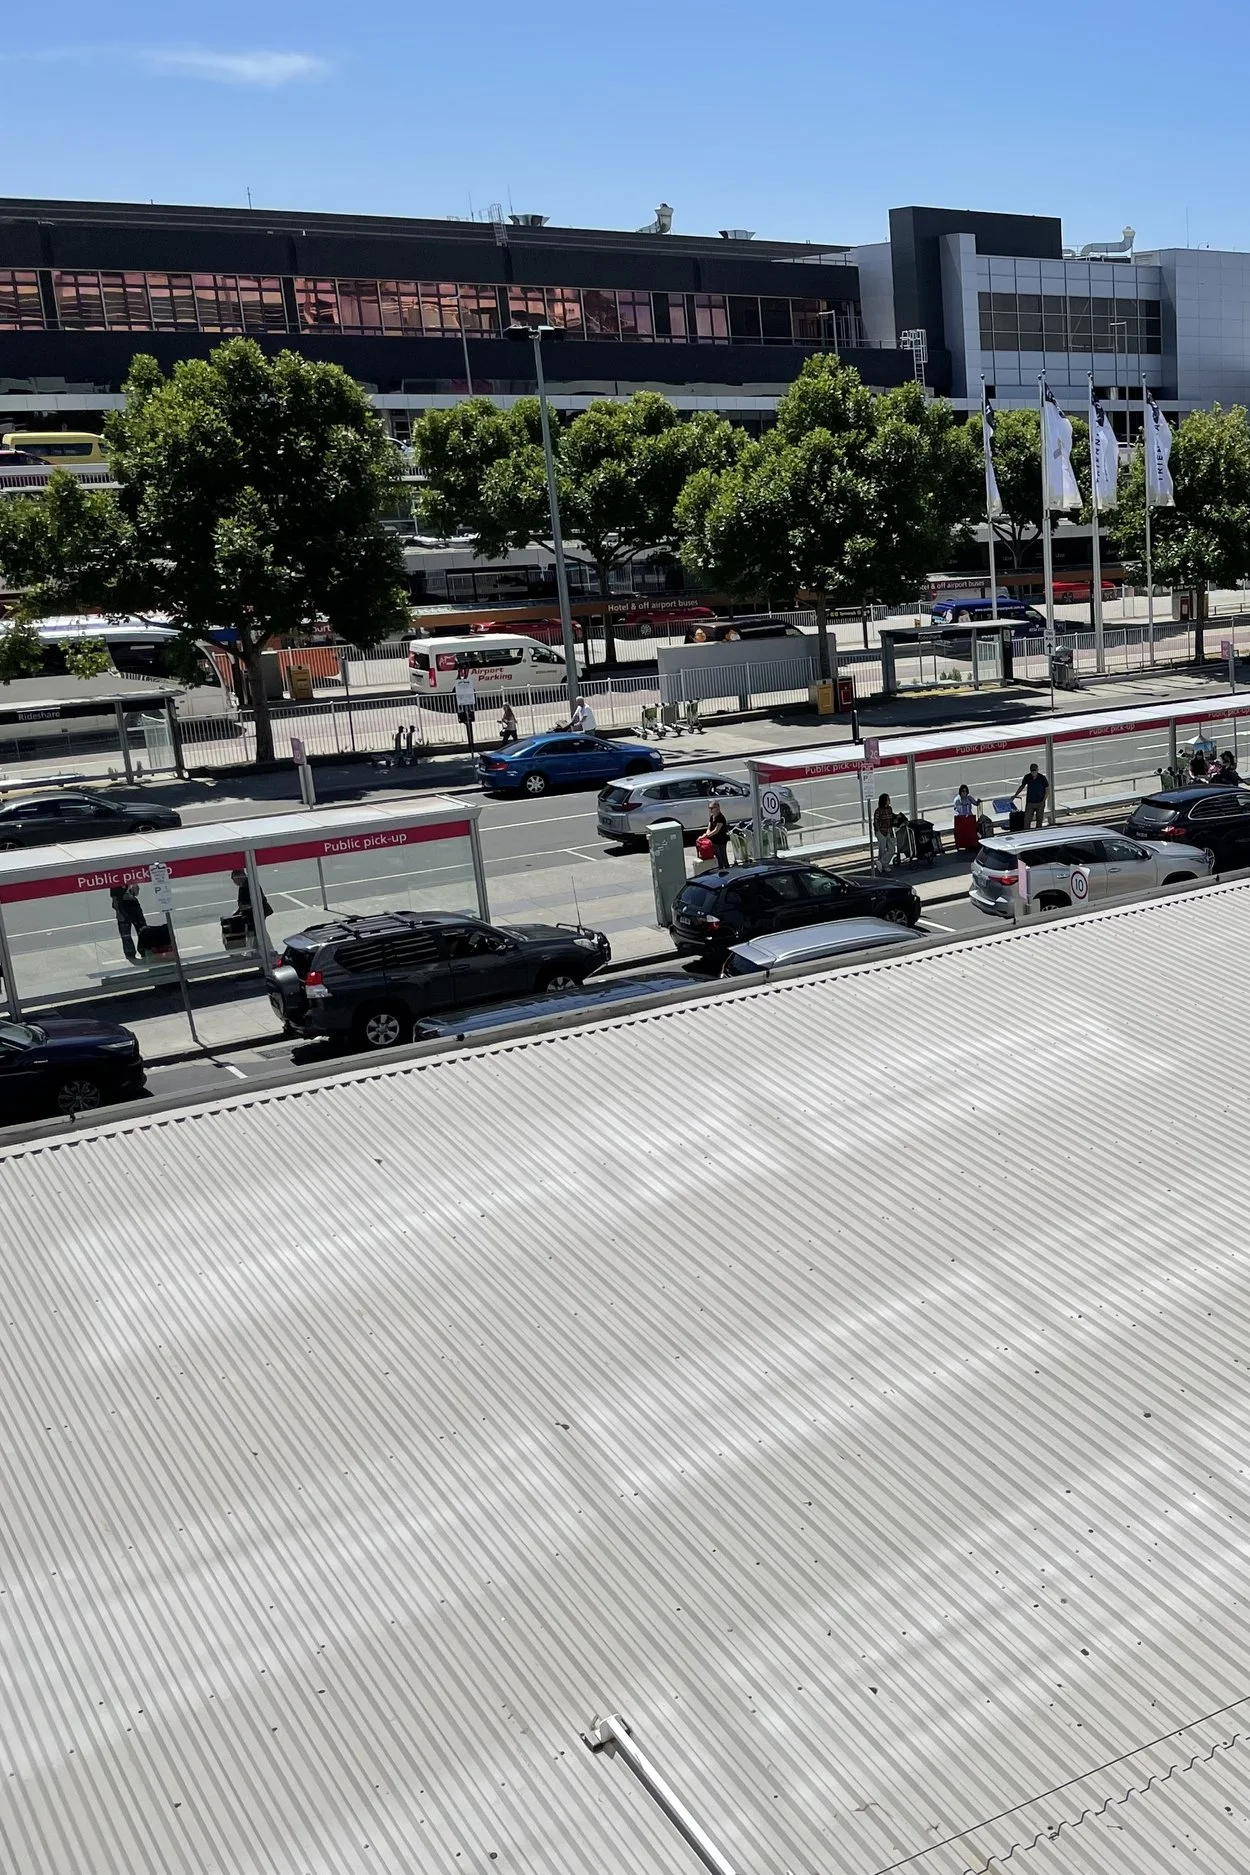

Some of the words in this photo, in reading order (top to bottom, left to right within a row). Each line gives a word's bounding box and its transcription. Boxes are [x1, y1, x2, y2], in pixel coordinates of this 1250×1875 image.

[947, 581, 968, 589] airport
[968, 580, 985, 588] buses
[608, 603, 629, 612] Hotel
[638, 601, 649, 610] off
[651, 600, 678, 610] airport
[678, 599, 699, 607] buses
[471, 667, 504, 675] Airport
[18, 710, 60, 721] Rideshare
[805, 764, 831, 775] Public
[767, 797, 776, 809] 10
[324, 838, 361, 852] Public
[363, 833, 407, 849] pick-up
[77, 872, 119, 888] Public
[1075, 878, 1084, 892] 10
